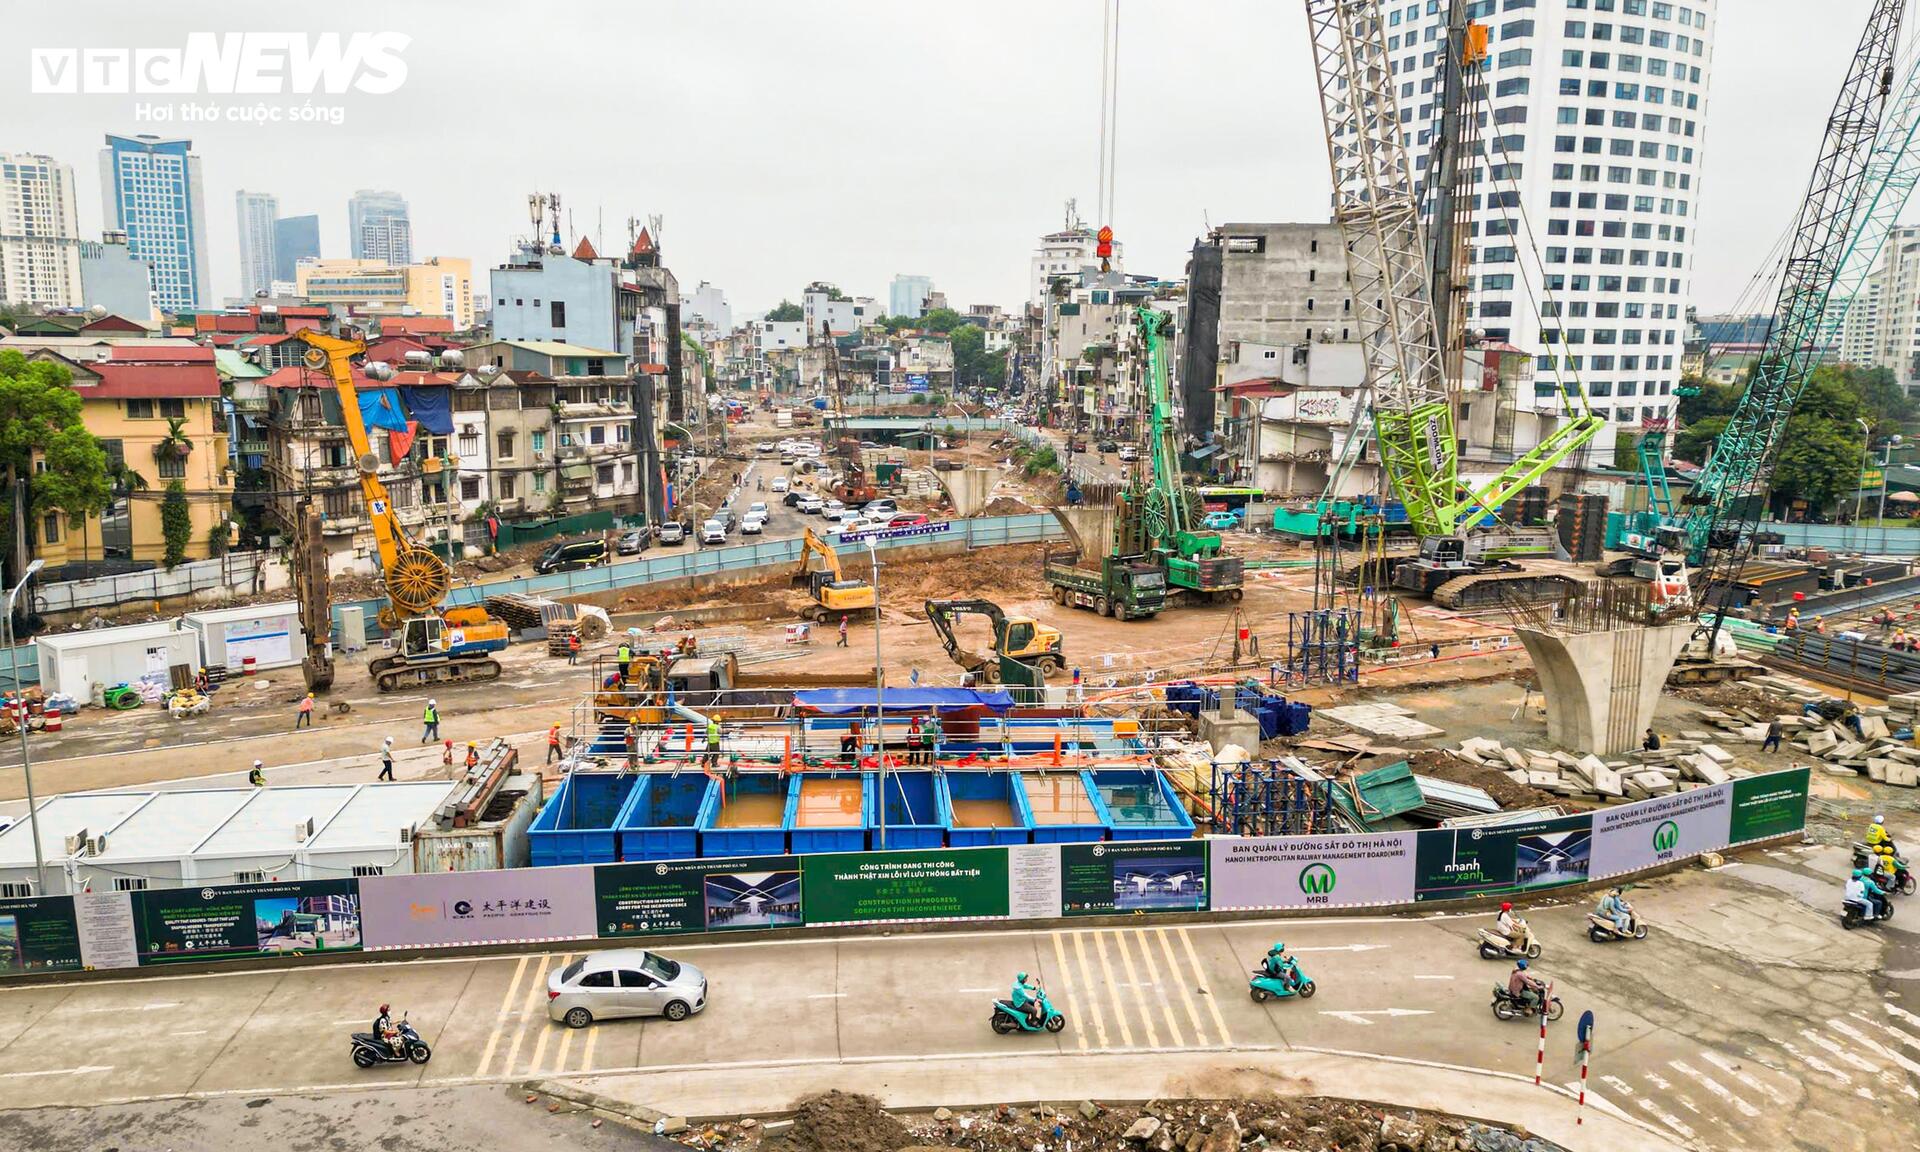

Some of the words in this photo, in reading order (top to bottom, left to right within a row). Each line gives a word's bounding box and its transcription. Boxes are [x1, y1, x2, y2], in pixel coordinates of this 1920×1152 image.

[1430, 419, 1442, 465] ZOOMLION
[1373, 839, 1386, 848] HÀ
[1387, 838, 1402, 848] NỘI
[880, 862, 902, 870] TRÌNH
[859, 872, 877, 880] THẬT
[903, 870, 910, 878] VÌ
[964, 868, 980, 877] TIỆN
[1455, 870, 1485, 884] xanh
[482, 898, 552, 912] 太平洋建设
[858, 898, 911, 906] CONSTRUCTION
[1306, 896, 1328, 904] MRB
